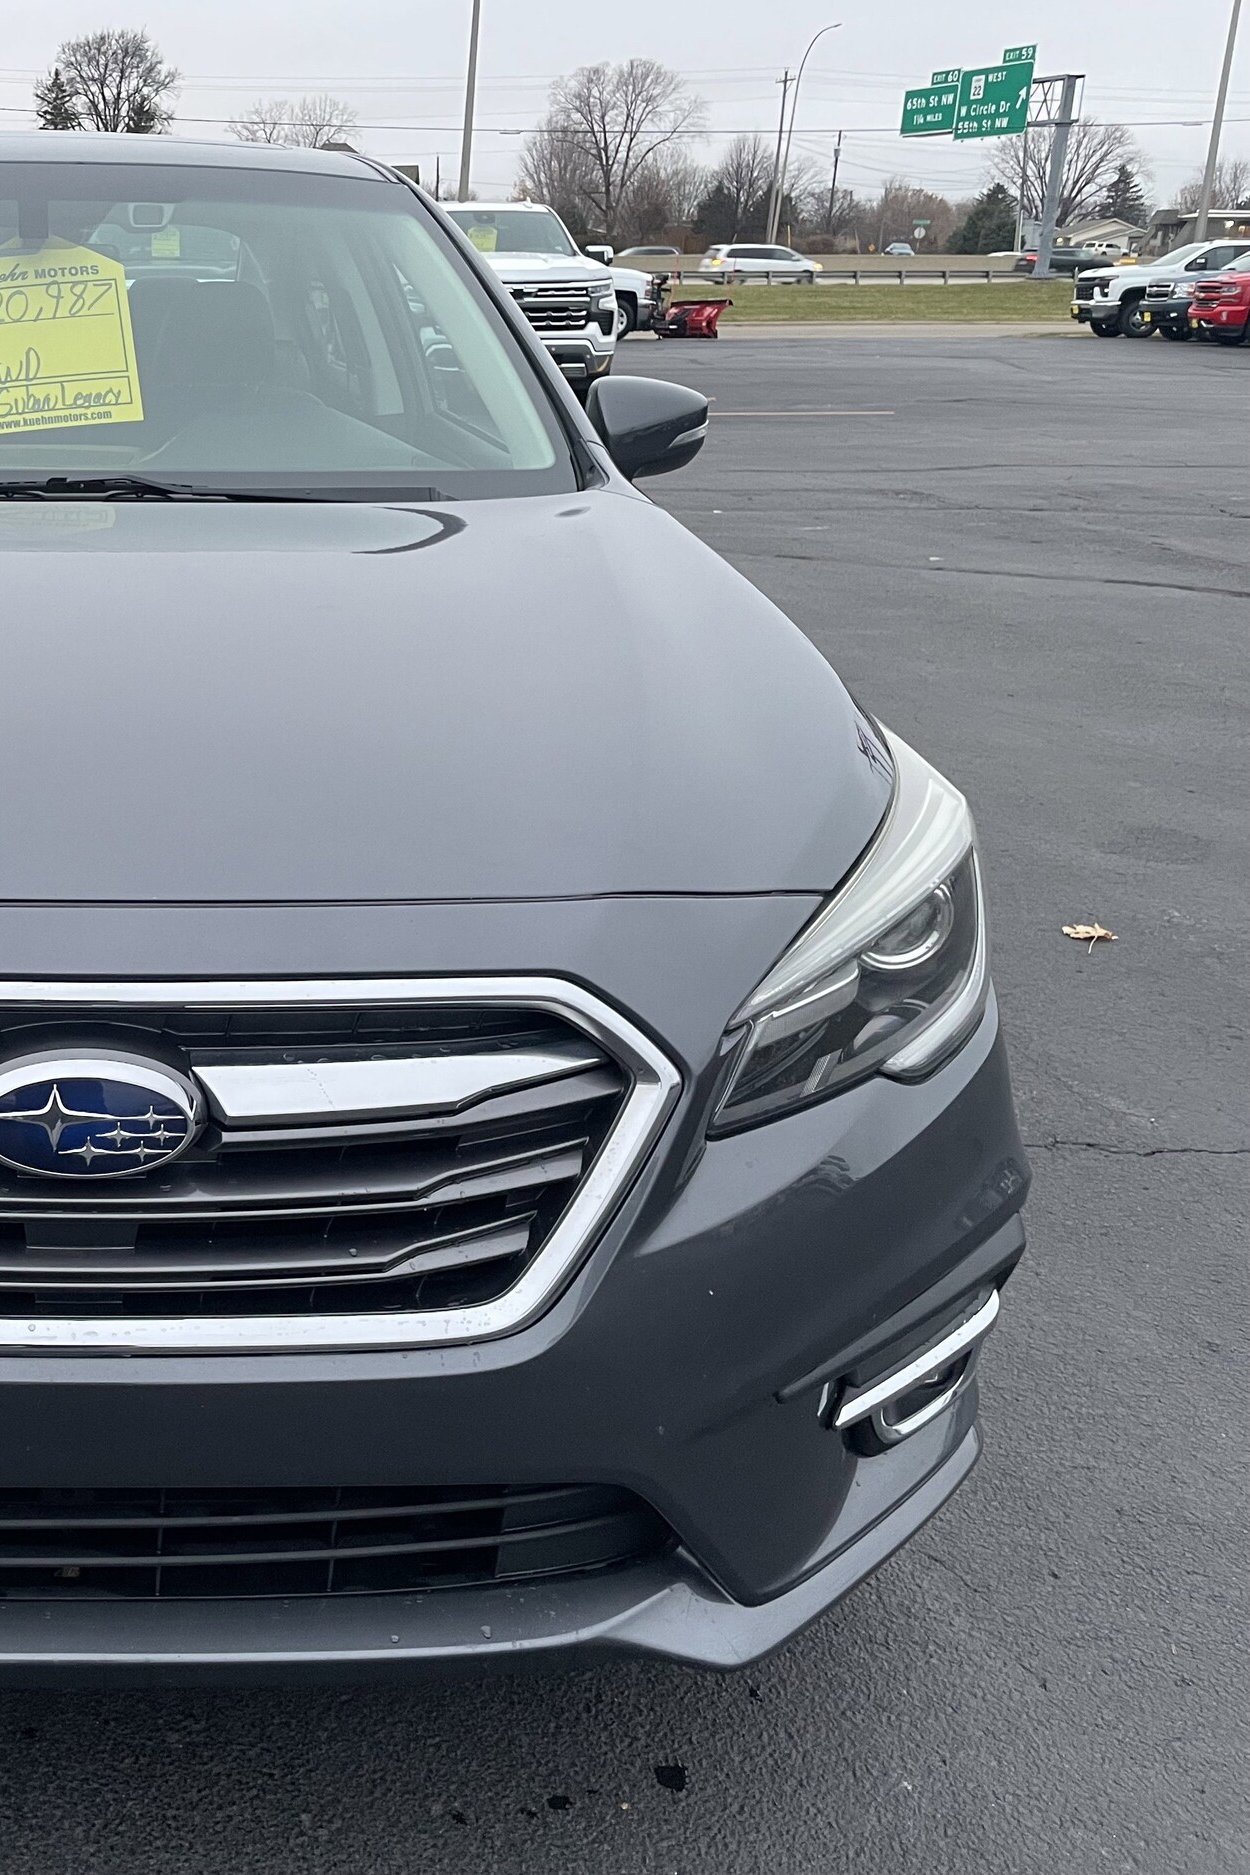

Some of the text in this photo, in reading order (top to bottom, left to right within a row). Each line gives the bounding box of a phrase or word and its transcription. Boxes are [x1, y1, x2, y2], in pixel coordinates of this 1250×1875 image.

[1005, 47, 1033, 61] EXIT 59
[933, 71, 959, 83] EXIT 60
[988, 71, 1007, 82] WEST
[972, 85, 982, 97] 22
[906, 93, 955, 110] 65th St NW
[960, 100, 1011, 117] W Circle Dr
[926, 113, 943, 122] MILES
[957, 117, 1009, 134] 55th St NW
[34, 265, 100, 279] MOTORS
[60, 382, 121, 409] Legacy
